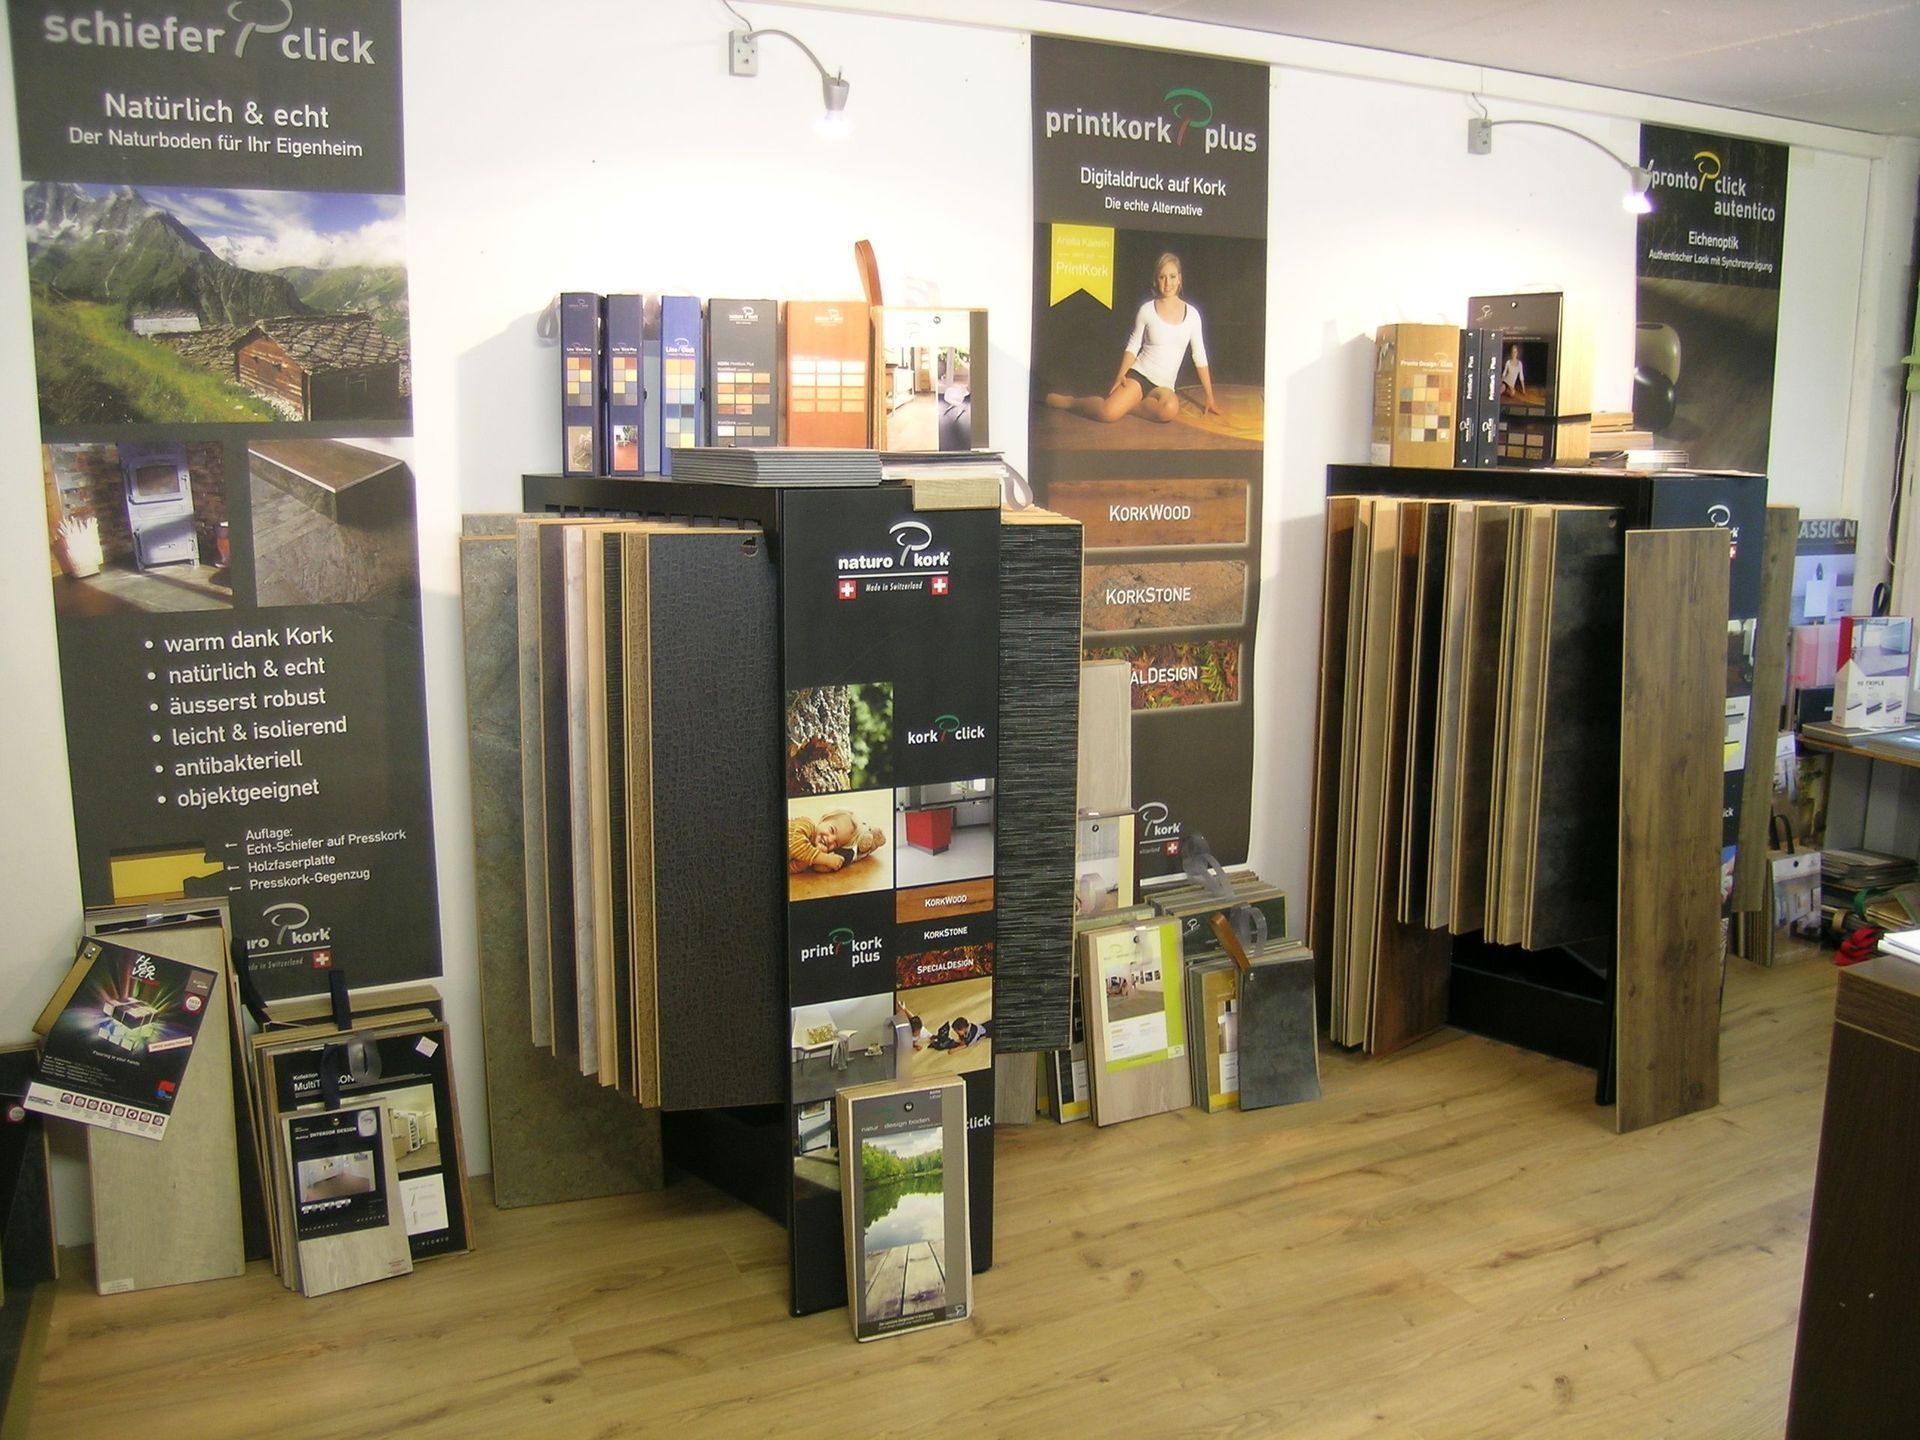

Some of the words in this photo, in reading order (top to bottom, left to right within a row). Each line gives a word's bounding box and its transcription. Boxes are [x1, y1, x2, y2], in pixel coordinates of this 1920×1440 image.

[44, 11, 225, 54] schiefer
[281, 29, 376, 65] click
[105, 93, 233, 124] Natürlich
[244, 102, 264, 125] &
[274, 104, 330, 128] echt
[69, 127, 103, 145] Der
[109, 128, 212, 150] Naturboden
[217, 134, 243, 152] für
[248, 136, 272, 153] Ihr
[277, 138, 363, 158] Eigenheim
[1046, 108, 1171, 144] printkork
[1205, 125, 1257, 154] plus
[1080, 167, 1164, 191] Digitaldruck
[1168, 178, 1190, 193] auf
[1193, 178, 1227, 197] Kork
[1651, 170, 1698, 190] pronto
[1714, 176, 1747, 197] click
[1105, 196, 1121, 210] Die
[1124, 200, 1150, 213] echte
[1152, 201, 1203, 216] Alternative
[1714, 200, 1775, 221] autentico
[1688, 231, 1739, 251] Eichenoptik
[1056, 261, 1108, 277] PrintKork
[1649, 249, 1693, 262] Authentischer
[1694, 253, 1709, 264] Look
[1711, 256, 1721, 266] mit
[1722, 256, 1773, 273] Synchronprägung
[1798, 519, 1841, 539] ASSIC
[838, 555, 893, 570] naturo
[914, 552, 948, 567] kork
[865, 583, 881, 592] Made
[882, 583, 889, 592] in
[890, 581, 923, 592] Switzerland
[164, 634, 225, 653] warm
[231, 629, 280, 649] dank
[286, 626, 334, 646] Kork
[169, 661, 257, 684] natürlich
[263, 659, 279, 678] &
[284, 657, 326, 676] echt
[170, 692, 257, 716] äusserst
[264, 688, 327, 709] robust
[172, 727, 226, 746] leicht
[232, 724, 248, 742] &
[253, 716, 348, 741] isolierend
[908, 729, 939, 745] kork
[955, 725, 986, 741] click
[175, 750, 304, 777] antibakteriell
[177, 778, 321, 810] objektgeeignet
[246, 828, 294, 842] Auflage:
[1155, 823, 1181, 836] kork
[247, 838, 323, 856] Echt-Schiefer
[327, 835, 346, 848] auf
[348, 829, 407, 845] Presskork
[248, 855, 336, 873] Holzfaserplatte
[250, 869, 371, 891] Presskork-Gegenzug
[292, 928, 330, 945] kork
[801, 943, 835, 963] print
[852, 936, 883, 952] kork
[851, 950, 881, 968] plus
[267, 956, 305, 968] Switzerland
